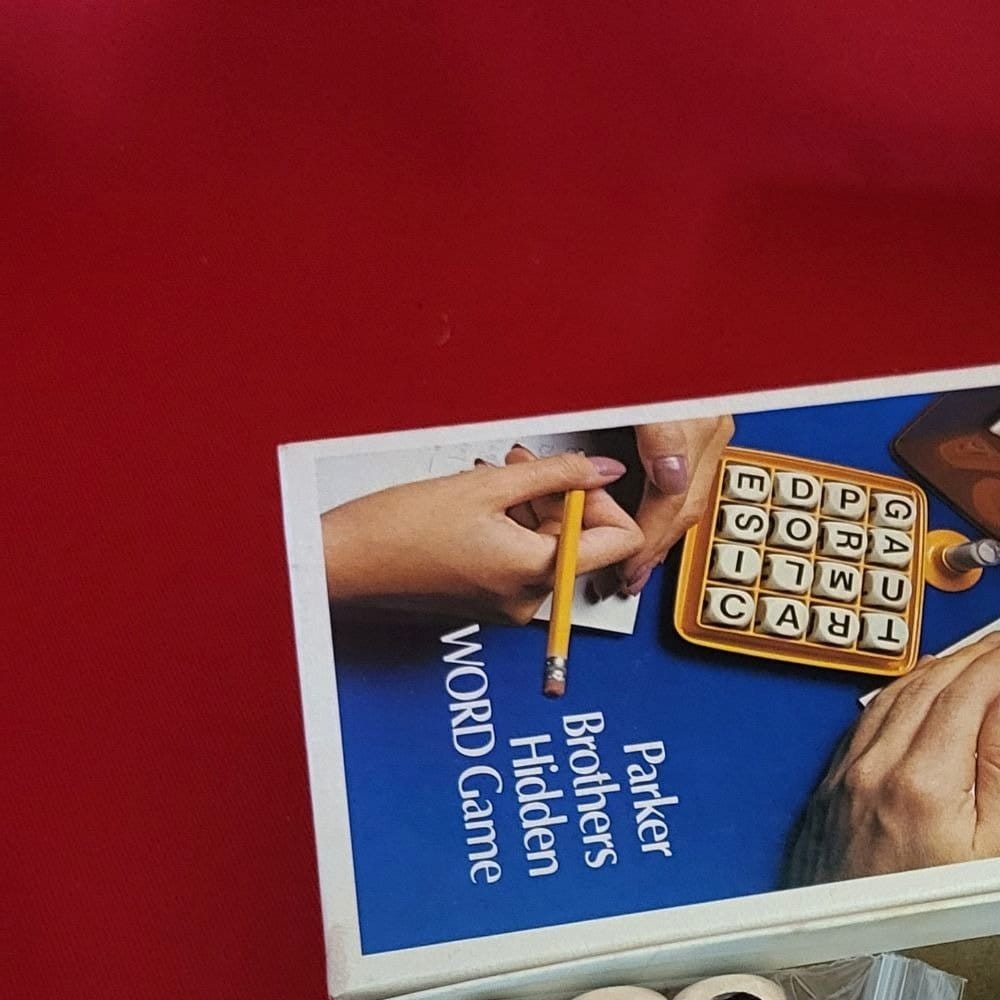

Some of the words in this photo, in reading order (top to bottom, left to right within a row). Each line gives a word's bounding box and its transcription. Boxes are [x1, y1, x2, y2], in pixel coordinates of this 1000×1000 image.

[735, 514, 763, 532] S
[786, 518, 811, 541] O
[837, 531, 862, 550] R
[883, 535, 909, 553] A
[738, 473, 764, 491] E
[792, 478, 813, 499] D
[841, 489, 860, 509] P
[885, 500, 912, 520] G
[720, 594, 746, 619] C
[776, 604, 799, 629] A
[828, 612, 850, 638] R
[878, 619, 899, 643] T
[786, 560, 804, 585] L
[882, 577, 904, 601] U
[441, 624, 495, 756] WORD
[458, 766, 502, 883] Game
[510, 735, 567, 876] Hidden
[562, 712, 620, 867] Brothers
[624, 741, 678, 856] Parker
